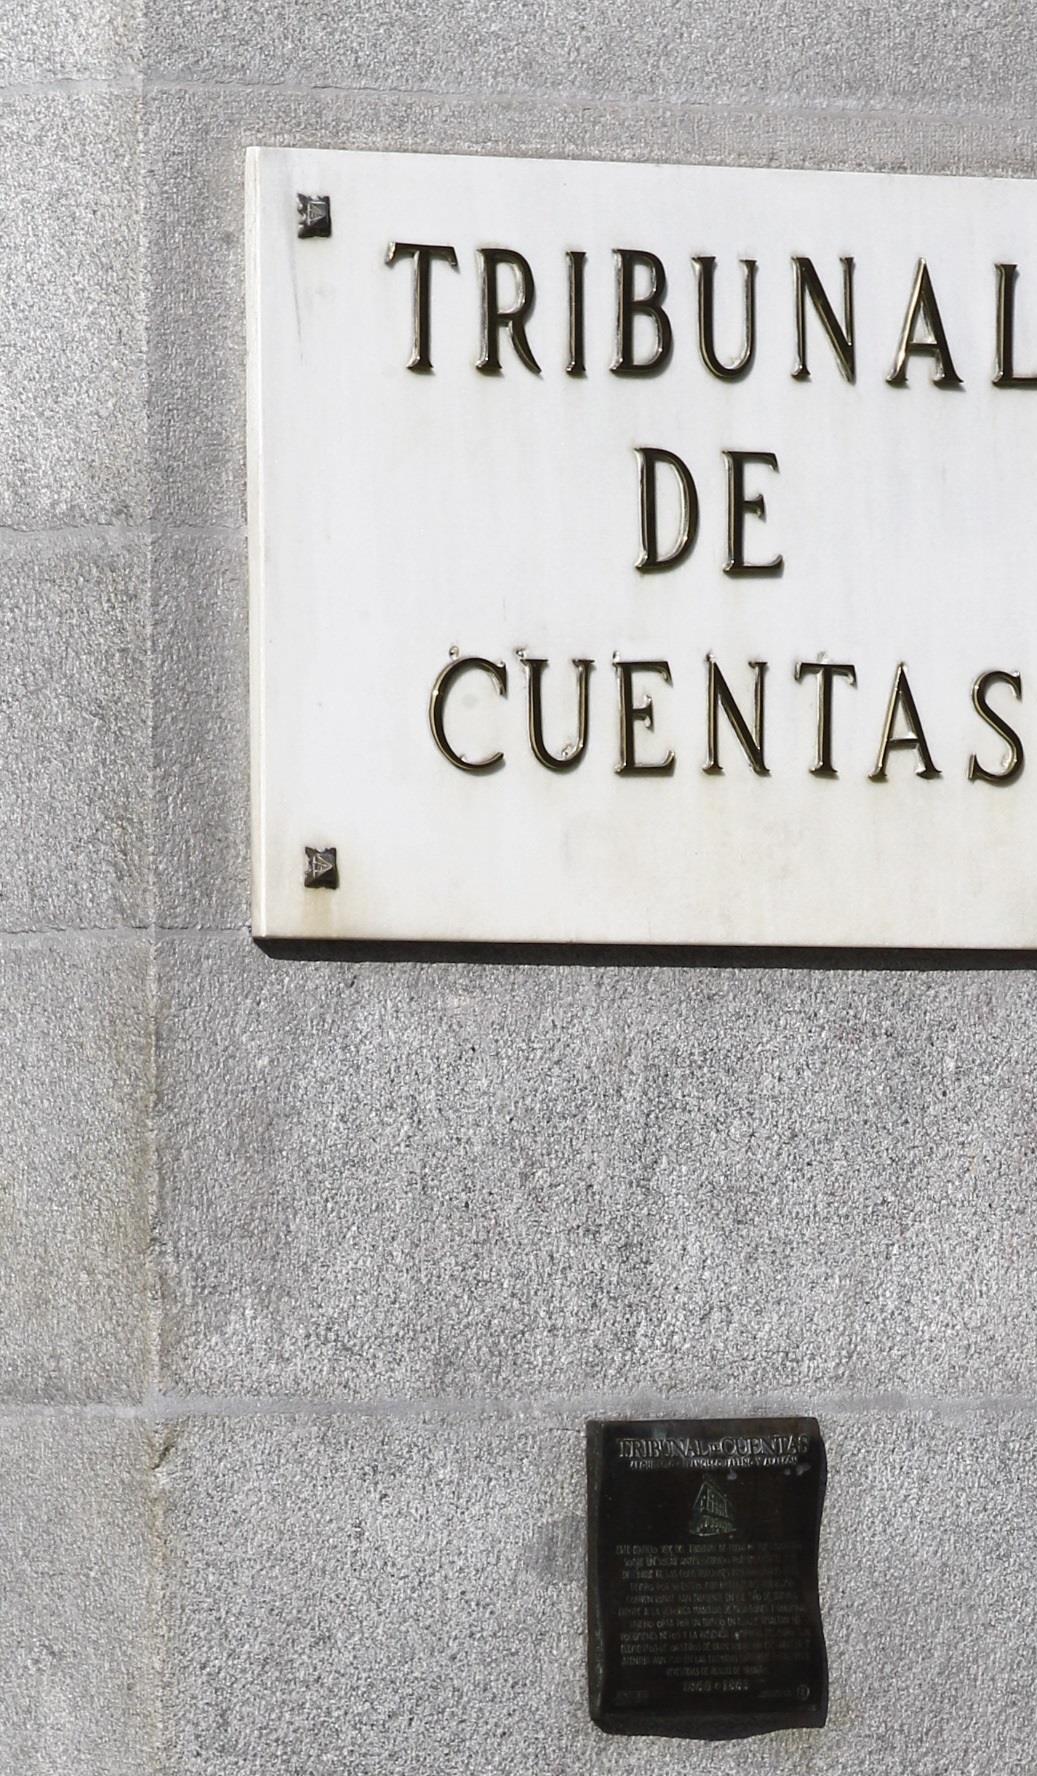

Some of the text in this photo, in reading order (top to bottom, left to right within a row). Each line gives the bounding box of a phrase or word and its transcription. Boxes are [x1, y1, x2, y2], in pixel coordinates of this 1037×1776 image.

[634, 446, 785, 576] DE
[428, 652, 1027, 786] CUENTAS
[618, 1436, 710, 1458] TRIBUNAL
[719, 1432, 810, 1456] CUENTAS
